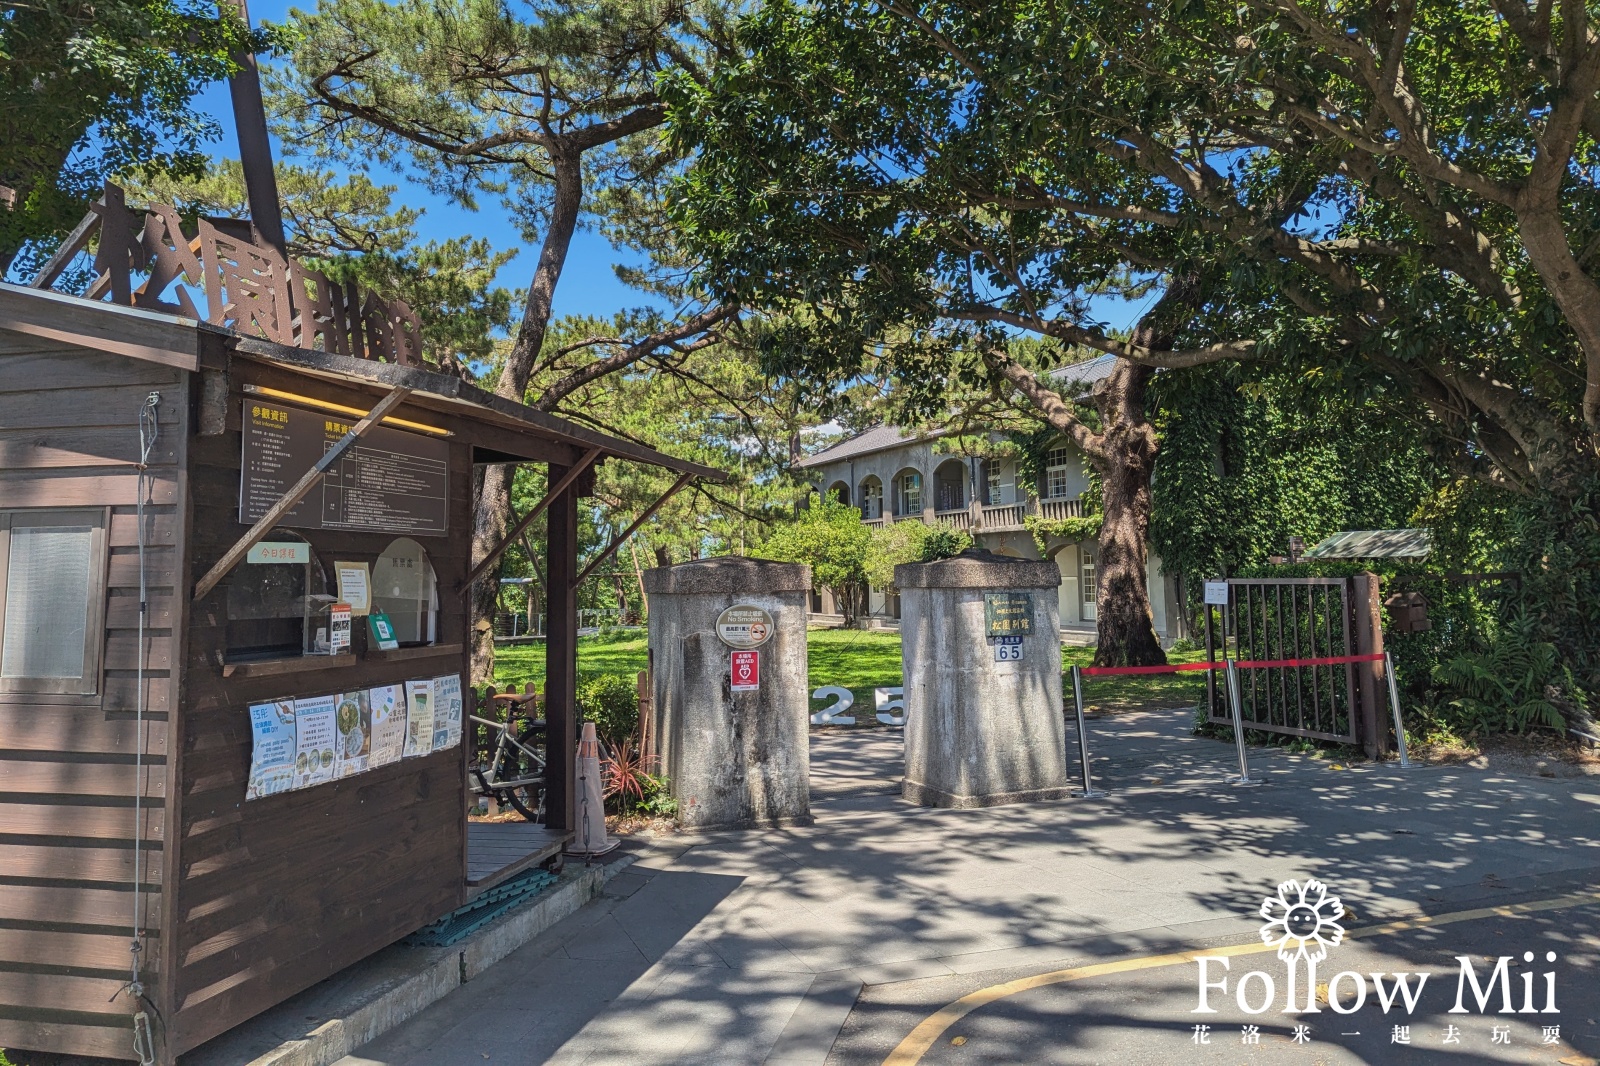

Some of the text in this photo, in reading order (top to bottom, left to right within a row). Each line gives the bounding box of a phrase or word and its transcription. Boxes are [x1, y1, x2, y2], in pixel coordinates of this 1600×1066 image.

[252, 406, 289, 424] 參觀資訊
[992, 618, 1029, 631] 松園別館
[999, 645, 1020, 660] 65
